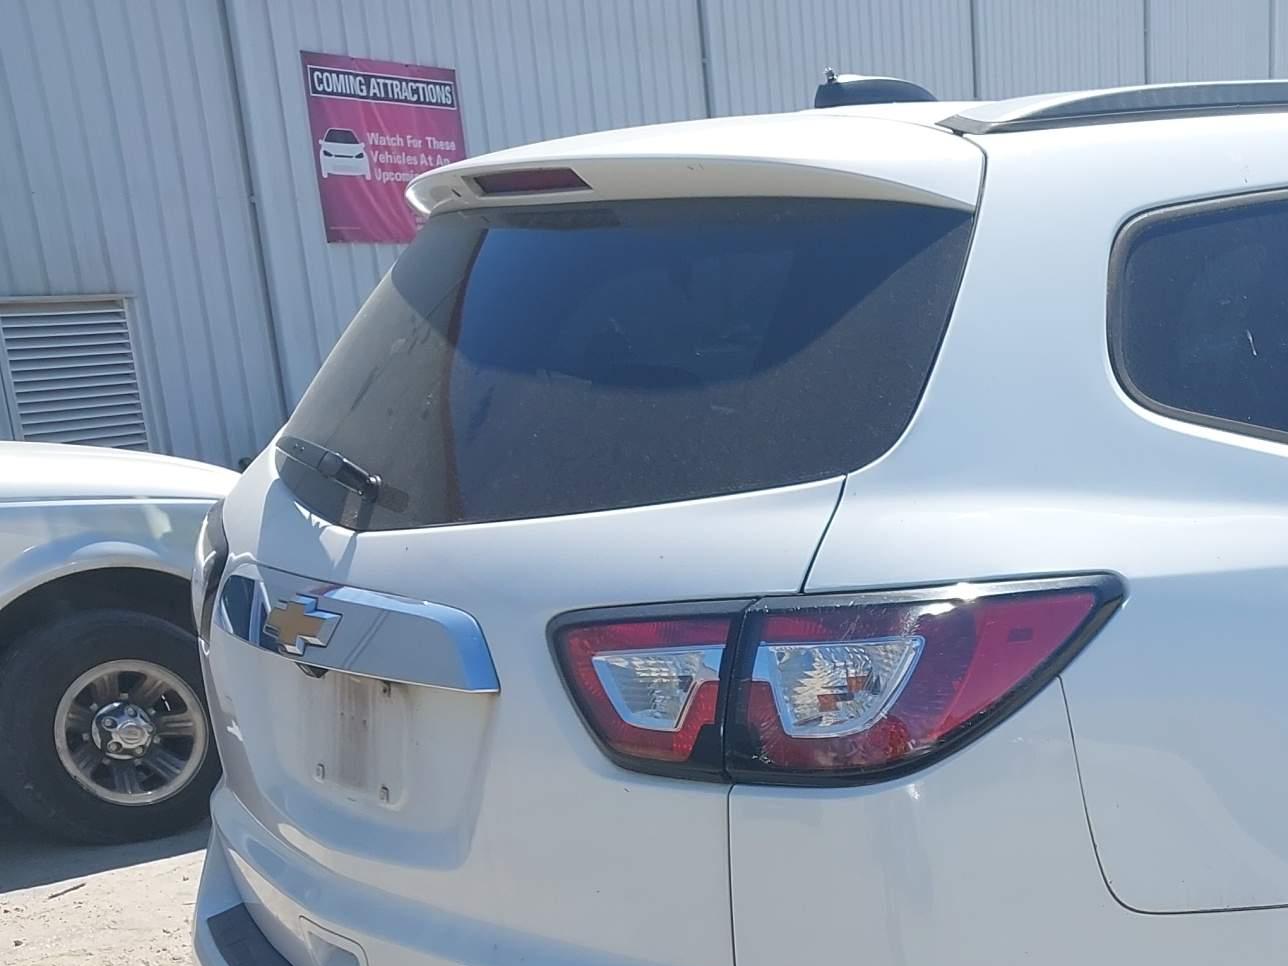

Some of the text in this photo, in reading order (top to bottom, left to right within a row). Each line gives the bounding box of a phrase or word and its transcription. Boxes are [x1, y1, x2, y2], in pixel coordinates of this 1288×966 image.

[313, 70, 453, 105] COMING ATTRACTIONS
[366, 132, 456, 151] Watch For These
[371, 150, 418, 166] Vehicles
[419, 153, 434, 167] At
